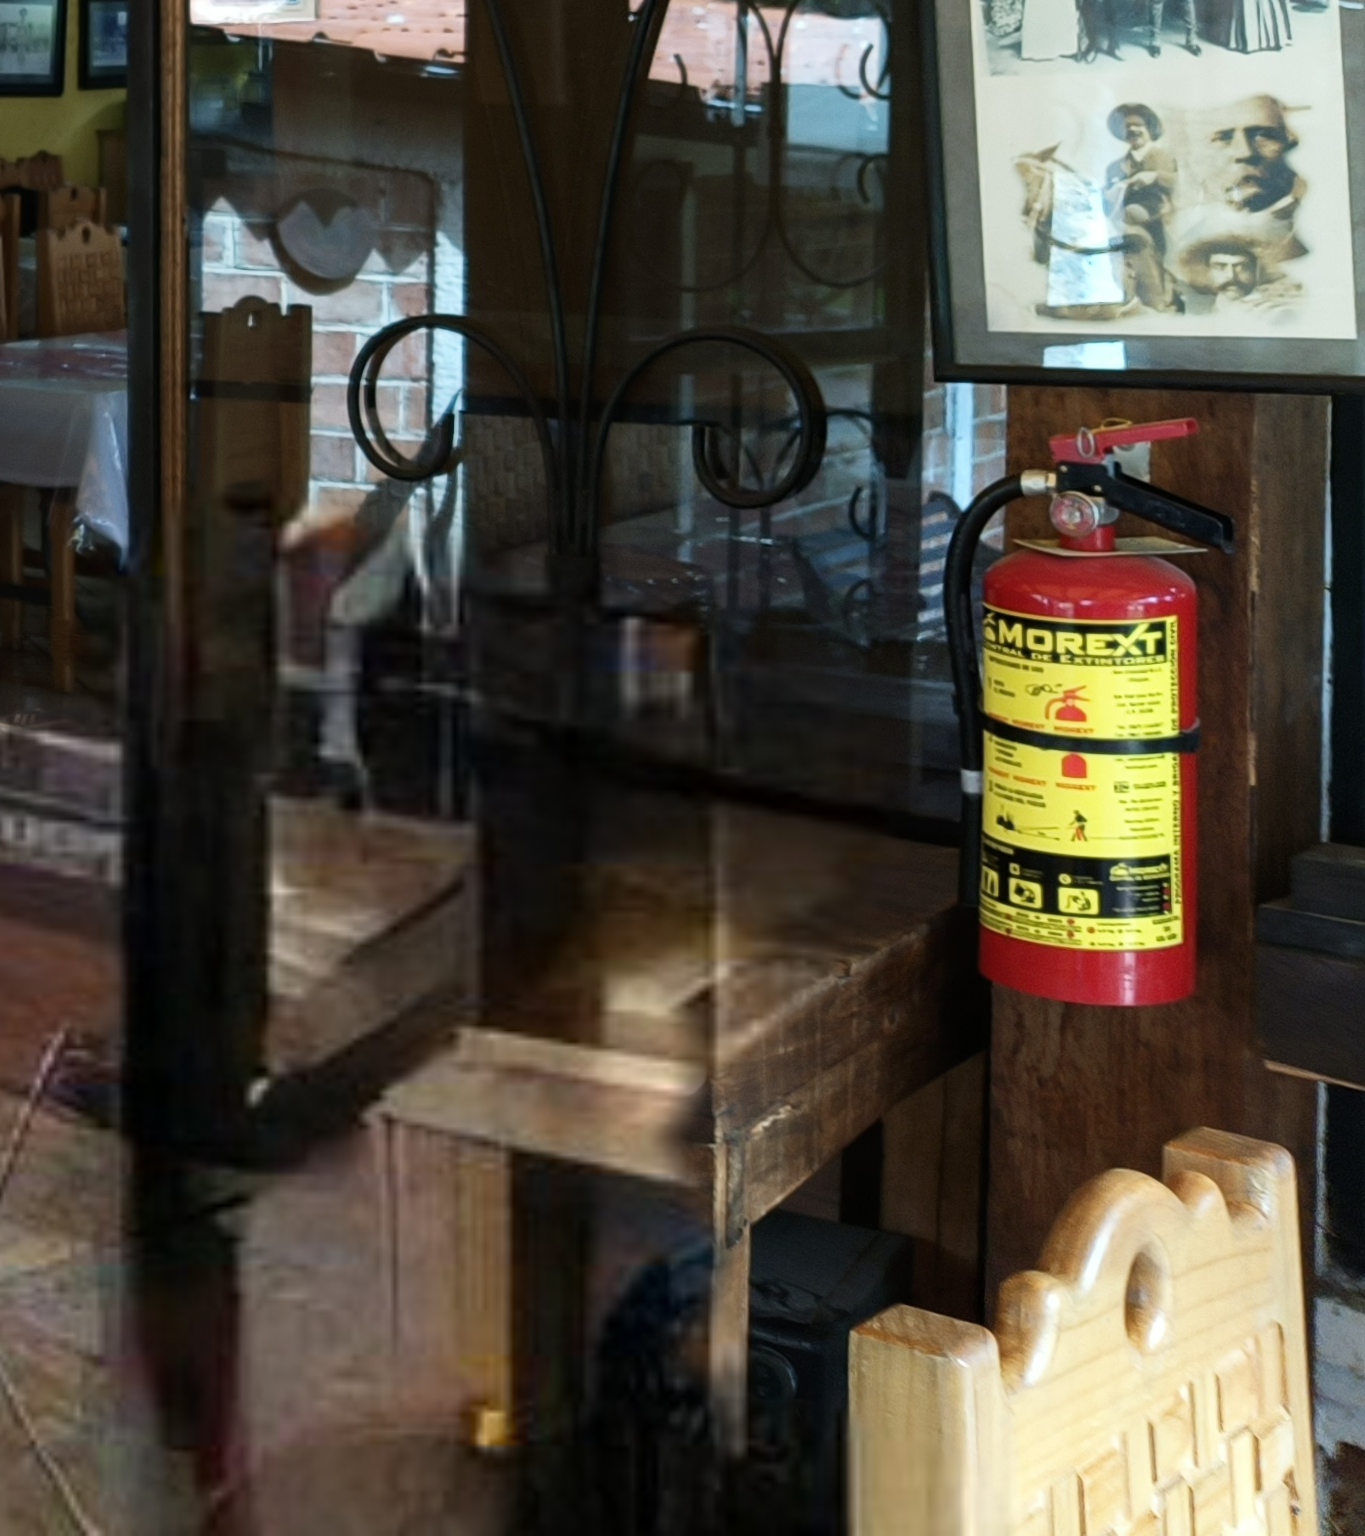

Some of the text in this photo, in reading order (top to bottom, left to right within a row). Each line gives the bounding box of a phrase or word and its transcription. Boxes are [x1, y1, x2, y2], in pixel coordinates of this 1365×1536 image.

[998, 619, 1163, 657] MOREXT
[1031, 652, 1053, 662] DE
[1059, 653, 1165, 667] EXTINTORES
